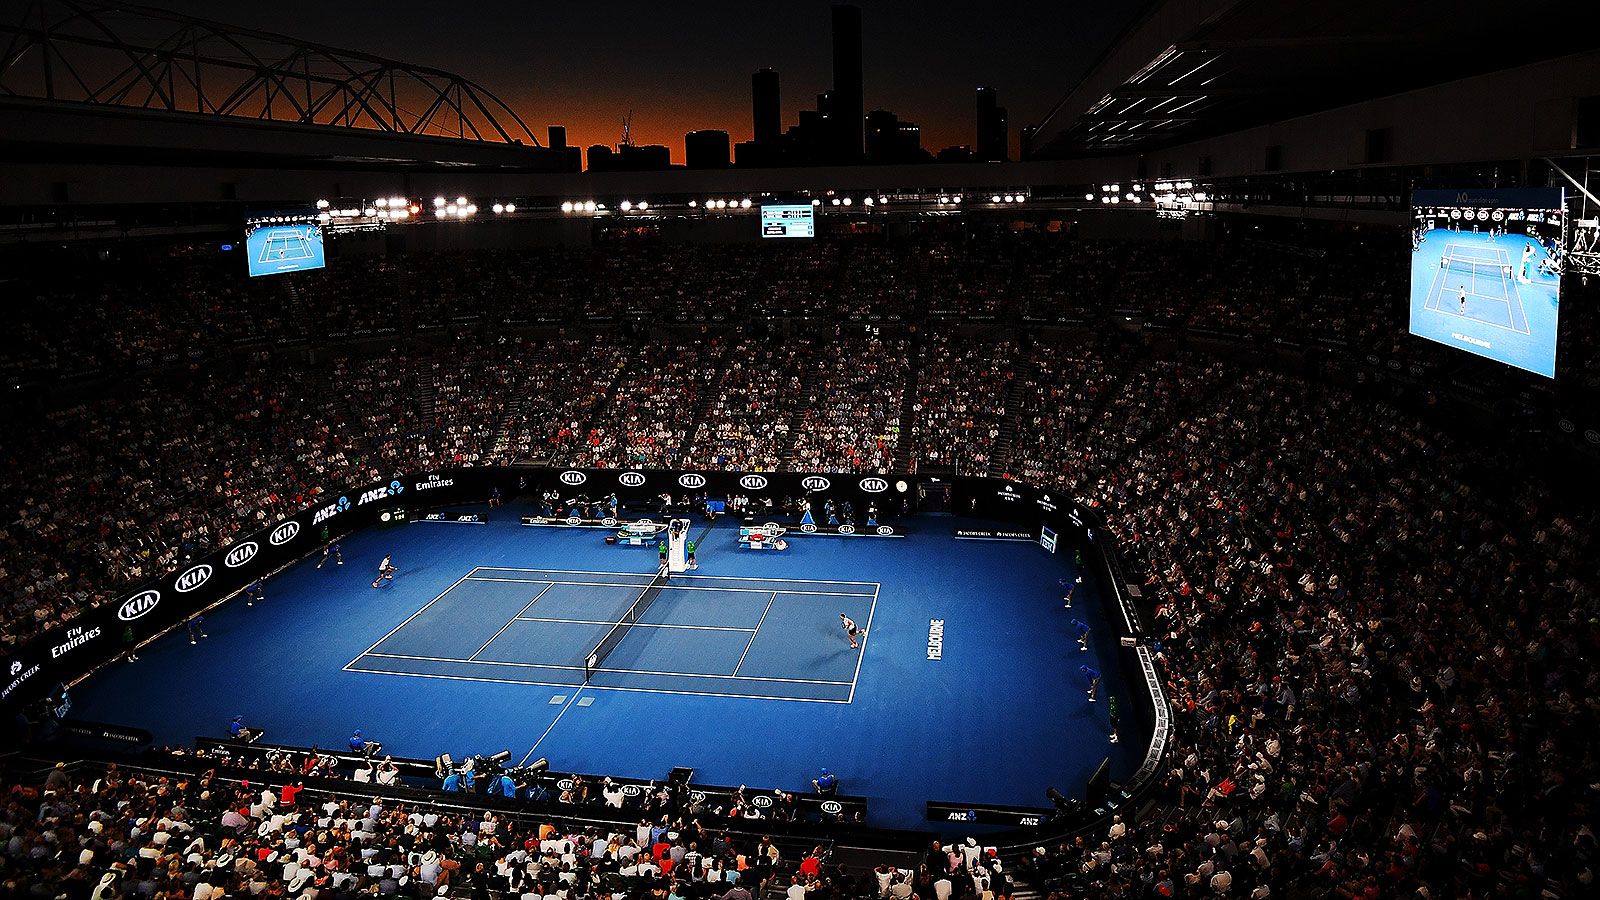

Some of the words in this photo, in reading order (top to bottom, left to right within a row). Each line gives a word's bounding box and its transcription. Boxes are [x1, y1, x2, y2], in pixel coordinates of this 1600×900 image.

[564, 473, 583, 483] KIA
[623, 474, 642, 484] KIA
[682, 476, 702, 486] KIA
[743, 477, 764, 487] KIA
[415, 478, 454, 491] Emirates
[806, 479, 826, 489] KIA
[864, 480, 884, 491] KIA
[358, 486, 388, 505] ANZ
[312, 503, 337, 526] ANZ
[274, 524, 296, 543] KIA
[230, 545, 254, 564] KIA
[181, 568, 207, 589] KIA
[124, 594, 155, 618] KIA
[51, 626, 101, 659] Emirates
[926, 618, 945, 661] MELBOURNE
[20, 663, 41, 682] CREEK
[559, 781, 574, 789] KIA
[623, 786, 637, 795] KIA
[754, 797, 770, 806] KIA
[823, 803, 838, 811] KIA
[947, 812, 967, 821] ANZ
[1019, 817, 1039, 826] ANZ
